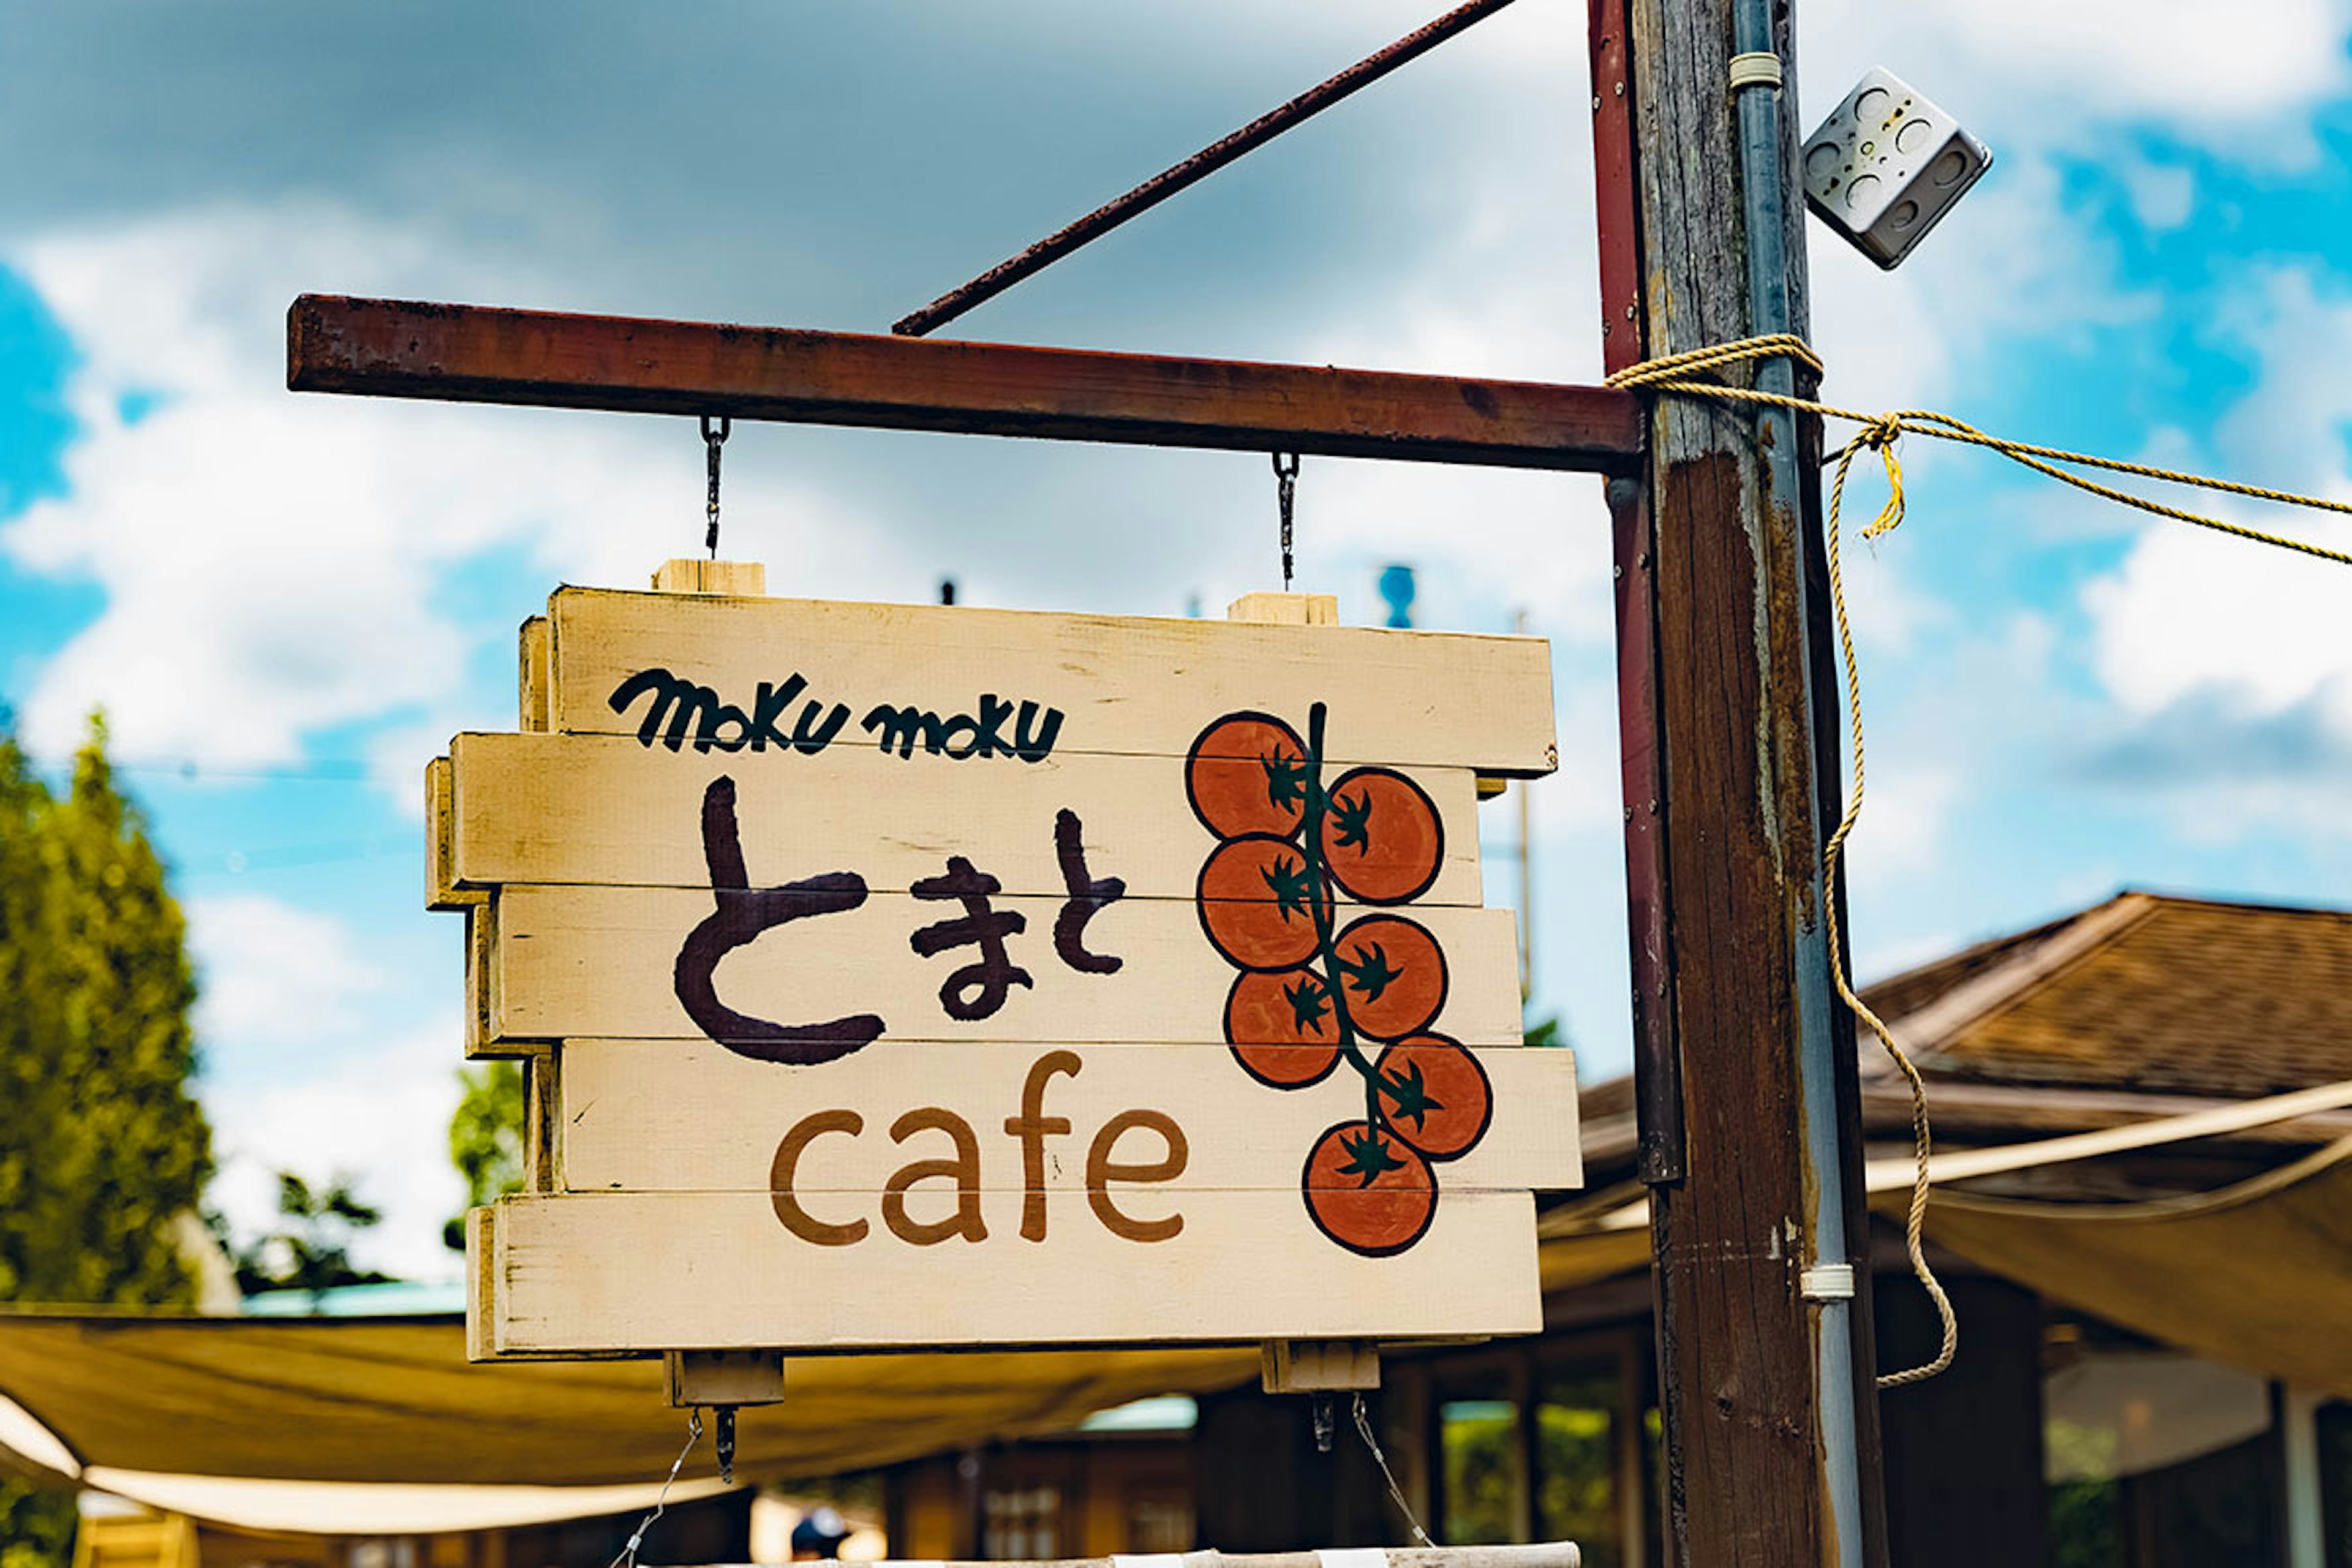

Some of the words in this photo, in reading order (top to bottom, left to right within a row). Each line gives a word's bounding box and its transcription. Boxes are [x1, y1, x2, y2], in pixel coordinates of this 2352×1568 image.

[674, 775, 1125, 1065] とまと
[771, 1050, 1189, 1246] cafe
